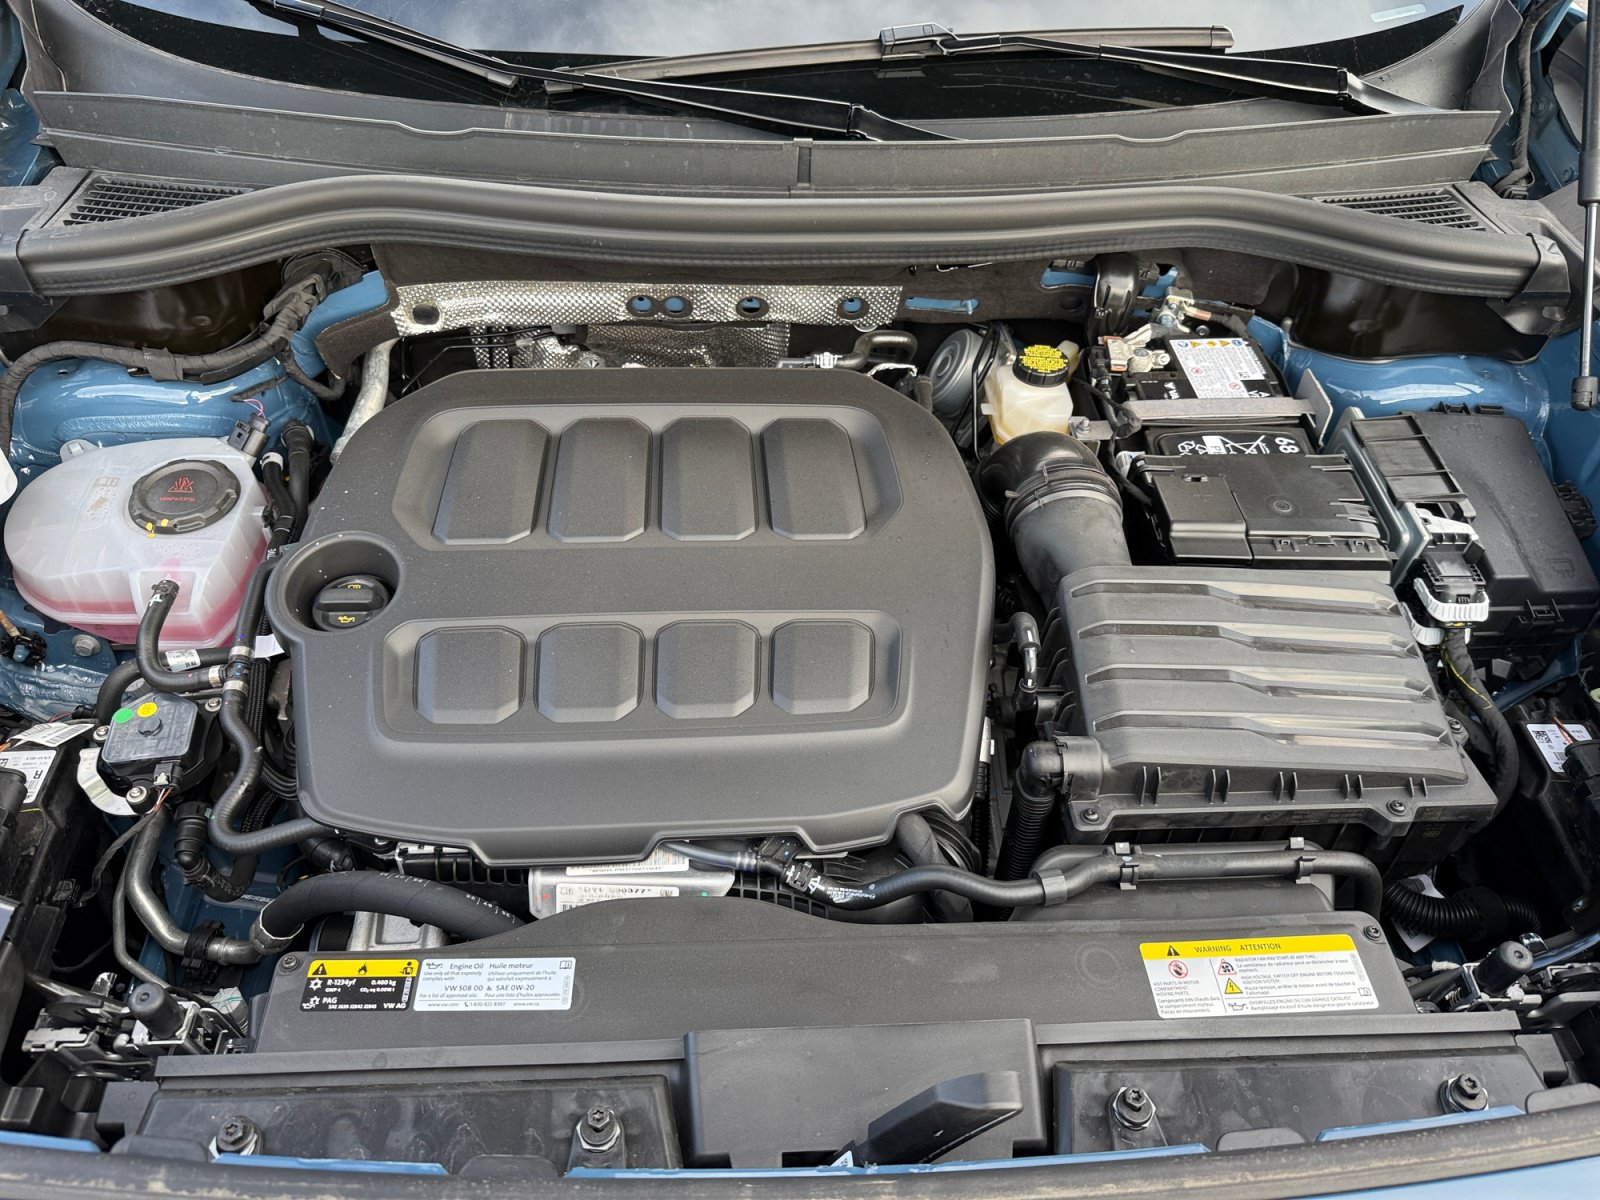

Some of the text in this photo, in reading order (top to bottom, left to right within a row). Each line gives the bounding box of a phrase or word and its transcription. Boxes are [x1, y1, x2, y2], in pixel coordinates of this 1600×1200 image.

[1275, 437, 1299, 454] 68
[33, 770, 43, 779] R
[1195, 943, 1281, 953] WARNING ATTENTION
[327, 978, 357, 987] R-1234yf
[389, 979, 397, 987] kg
[322, 996, 338, 1004] PAG
